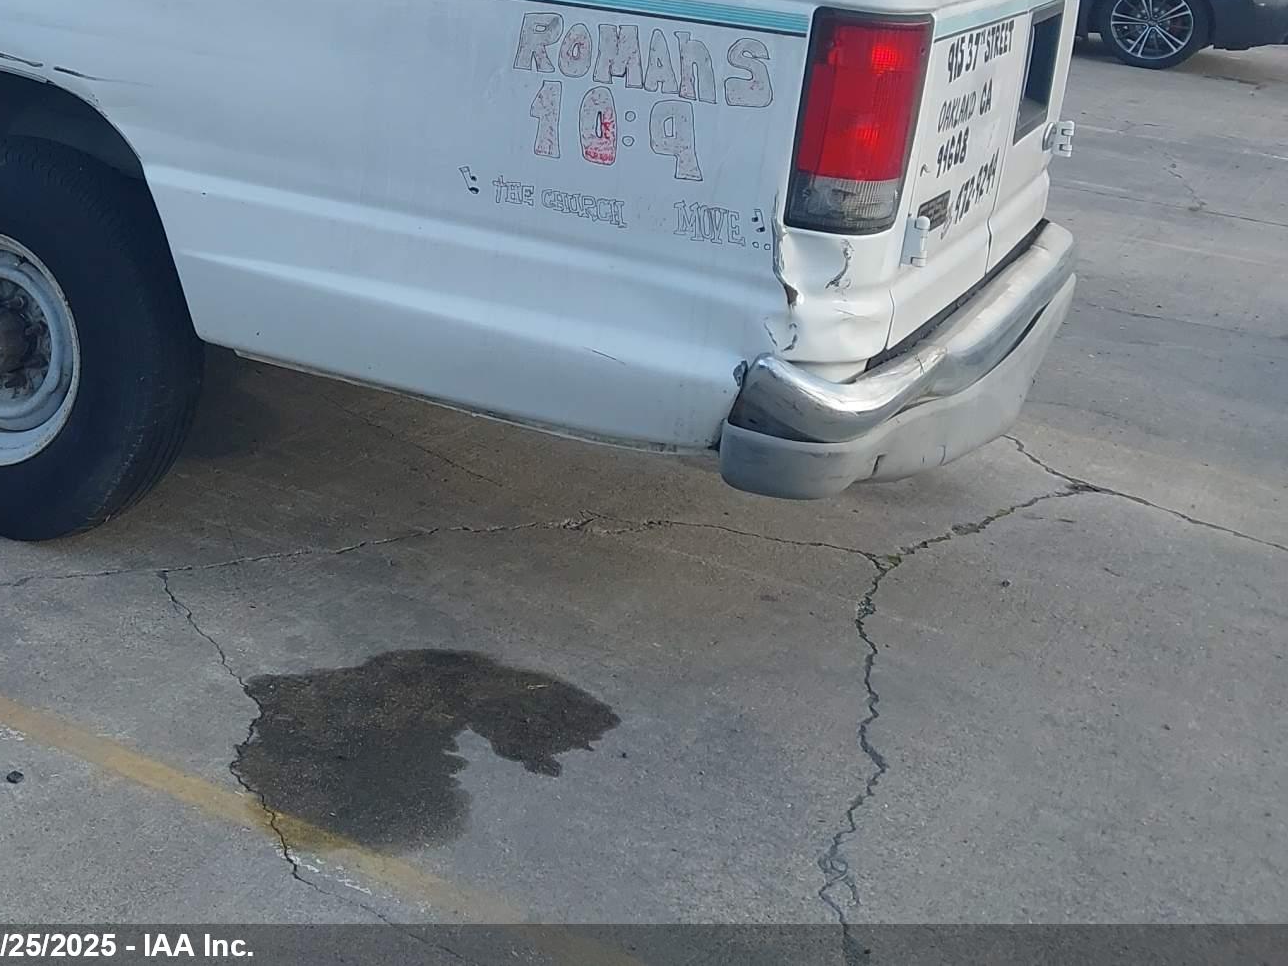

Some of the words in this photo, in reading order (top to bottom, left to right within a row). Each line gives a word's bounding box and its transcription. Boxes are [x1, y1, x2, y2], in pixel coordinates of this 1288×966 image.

[984, 19, 1015, 63] STREET
[530, 80, 704, 182] 10:9
[937, 89, 976, 134] OAKLAND
[979, 77, 993, 116] CA
[492, 175, 535, 207] THE
[541, 188, 627, 228] CHURCH
